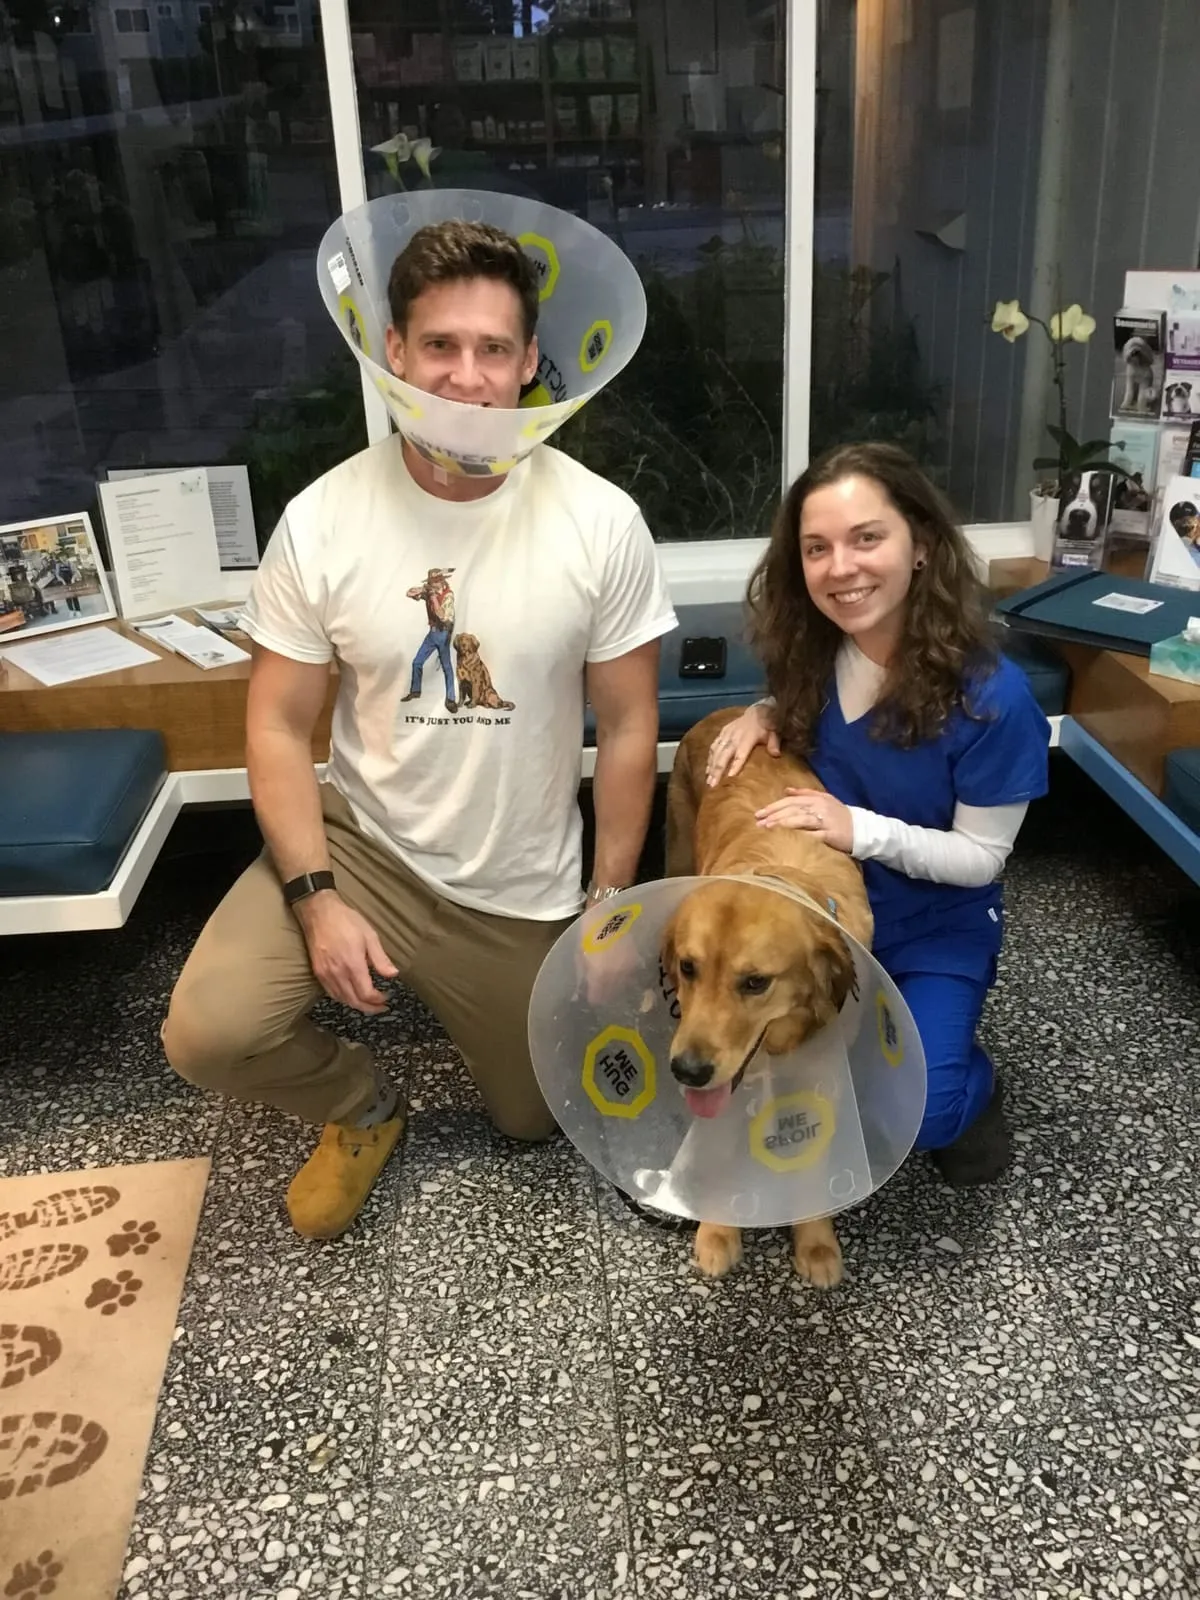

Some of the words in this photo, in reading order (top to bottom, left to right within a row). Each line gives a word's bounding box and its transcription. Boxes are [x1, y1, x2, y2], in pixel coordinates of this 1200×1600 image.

[405, 715, 425, 724] IT'S
[426, 717, 450, 726] JUST
[452, 716, 474, 725] YOU
[476, 716, 492, 726] AND
[495, 717, 511, 725] ME
